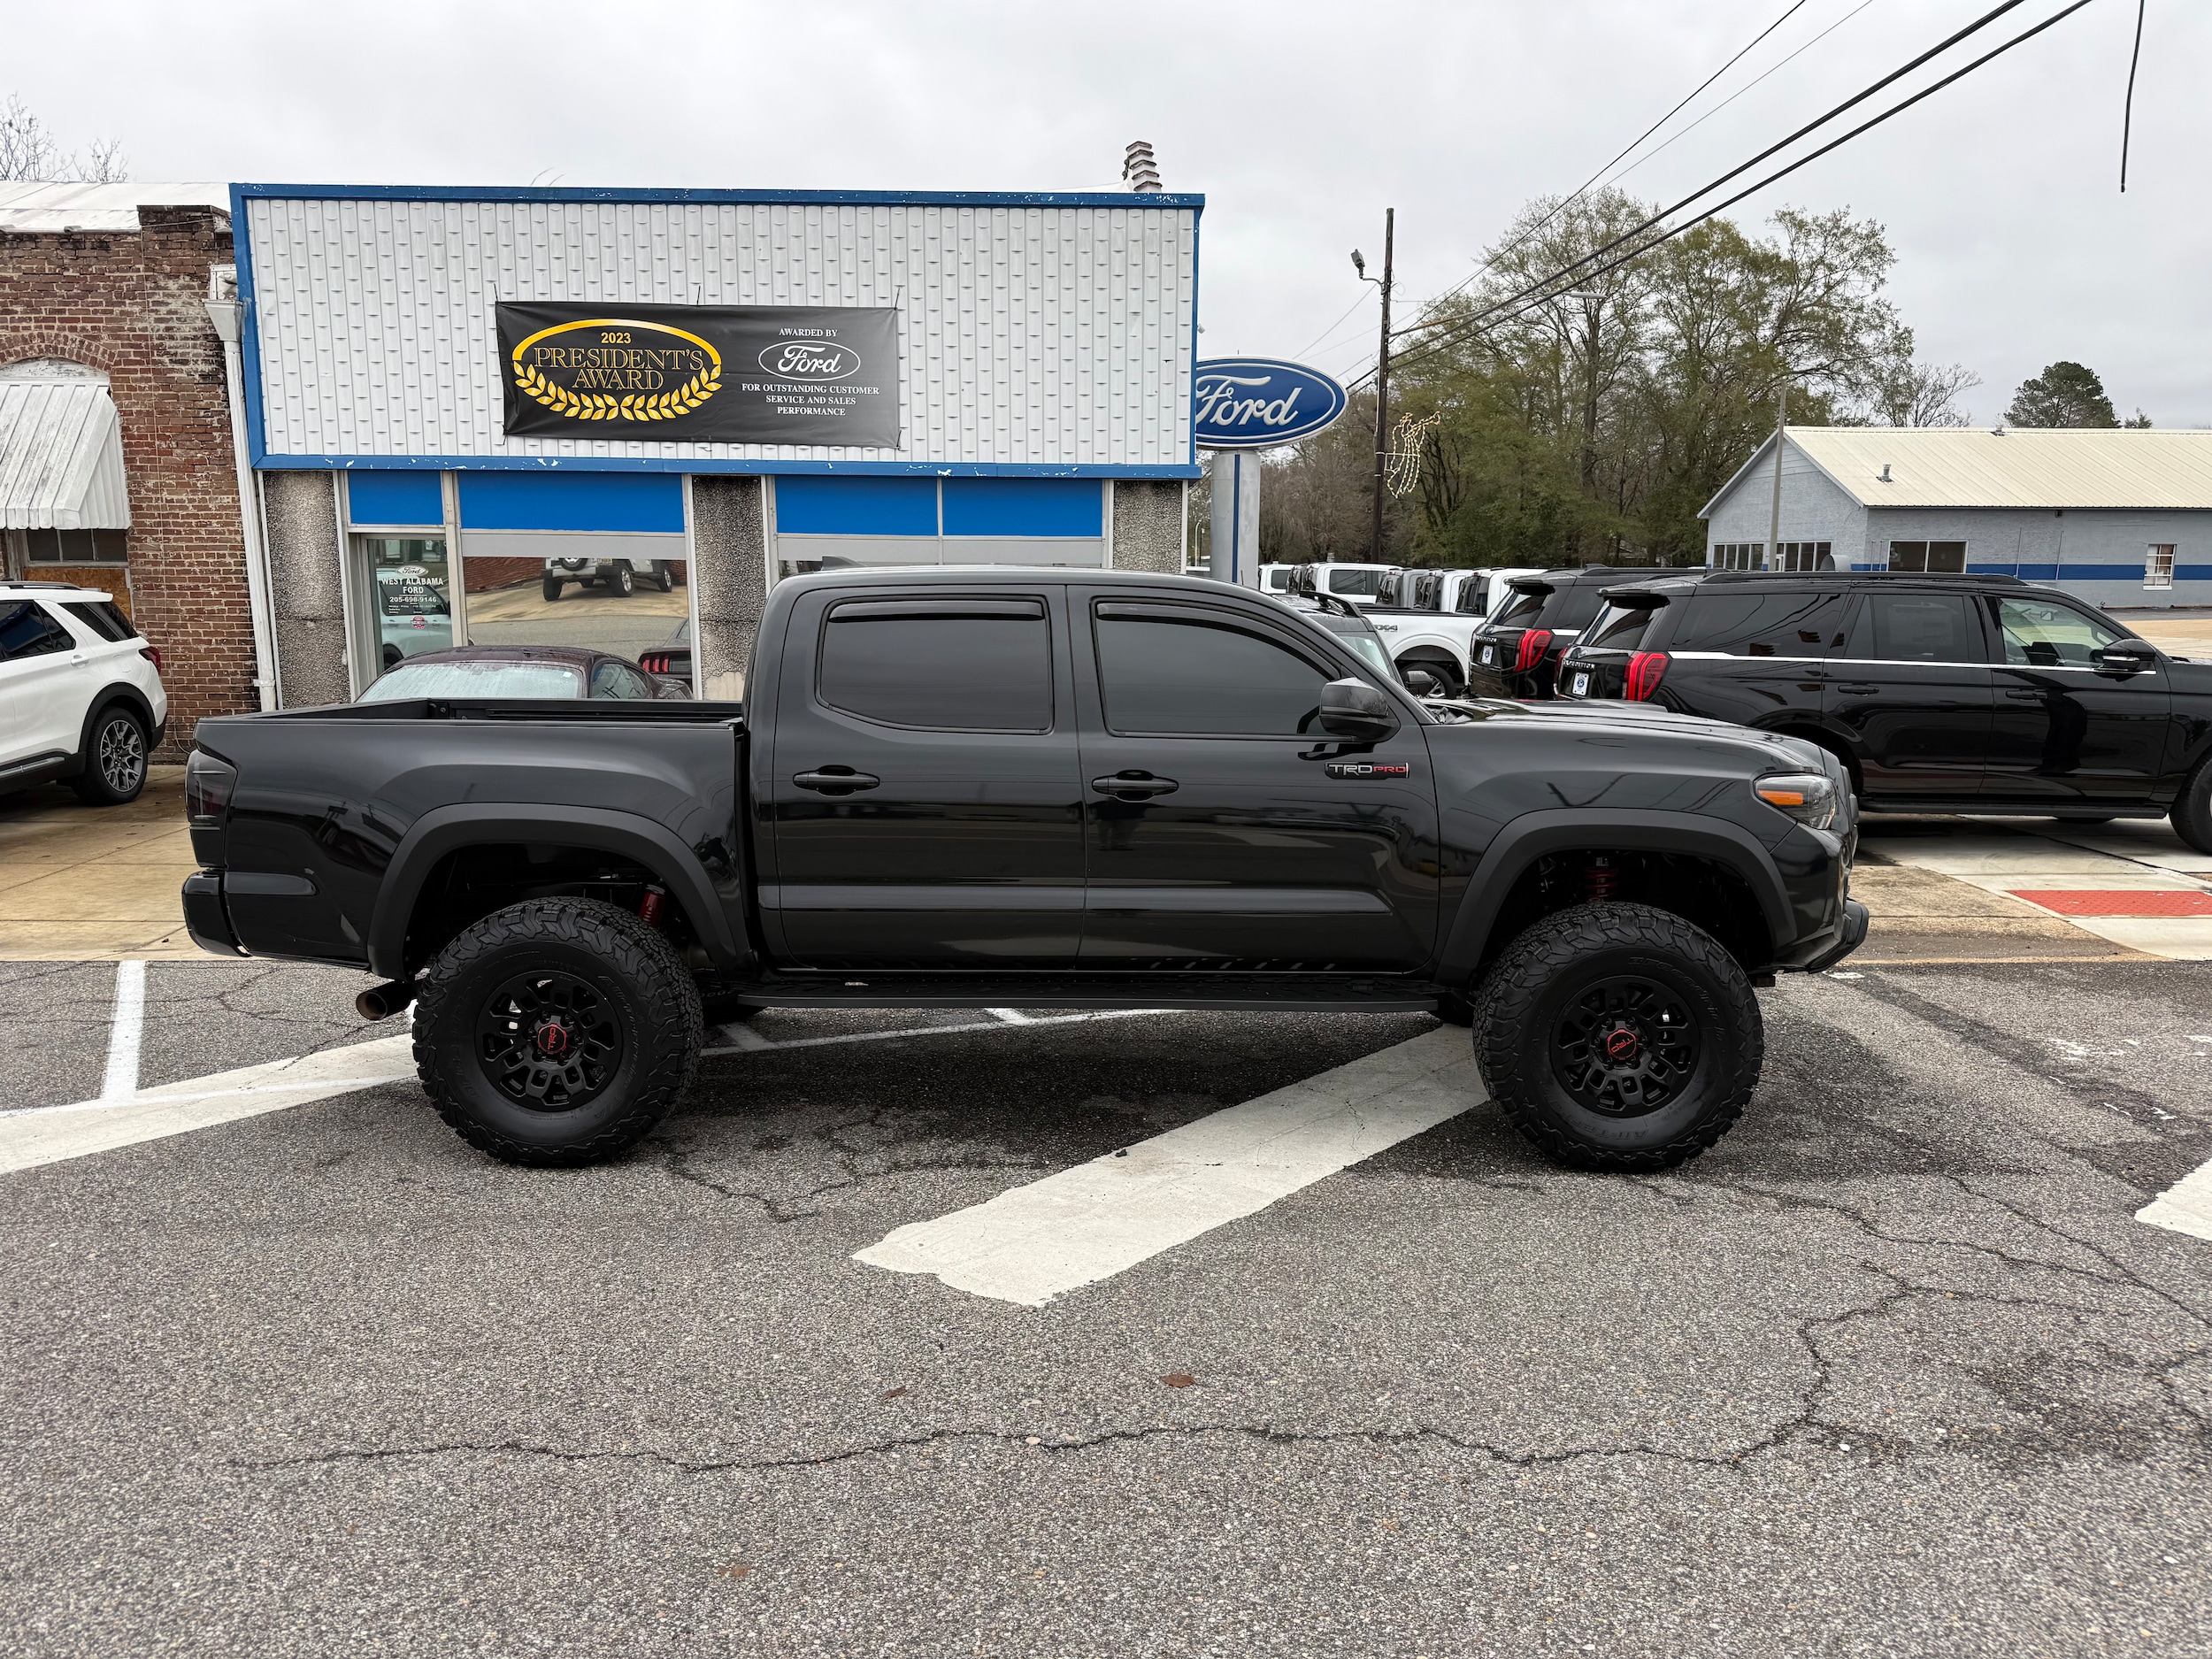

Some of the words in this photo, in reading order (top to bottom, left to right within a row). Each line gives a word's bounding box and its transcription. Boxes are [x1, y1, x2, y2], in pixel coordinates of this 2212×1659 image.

[601, 332, 632, 344] 2023
[779, 328, 823, 337] AWARDED
[534, 348, 704, 371] PRESIDENT'S
[777, 345, 841, 373] Ford
[572, 369, 664, 390] AWARD
[741, 383, 761, 392] FOR
[763, 384, 827, 394] OUTSTANDING
[829, 386, 879, 395] CUSTOMER
[765, 395, 805, 403] SERVICE
[1196, 374, 1303, 426] Ford
[777, 406, 846, 416] PERFORMANCE
[402, 566, 421, 575] Ford
[1329, 764, 1373, 776] TRD
[548, 1027, 557, 1050] TRD
[1611, 1038, 1634, 1053] TRD
